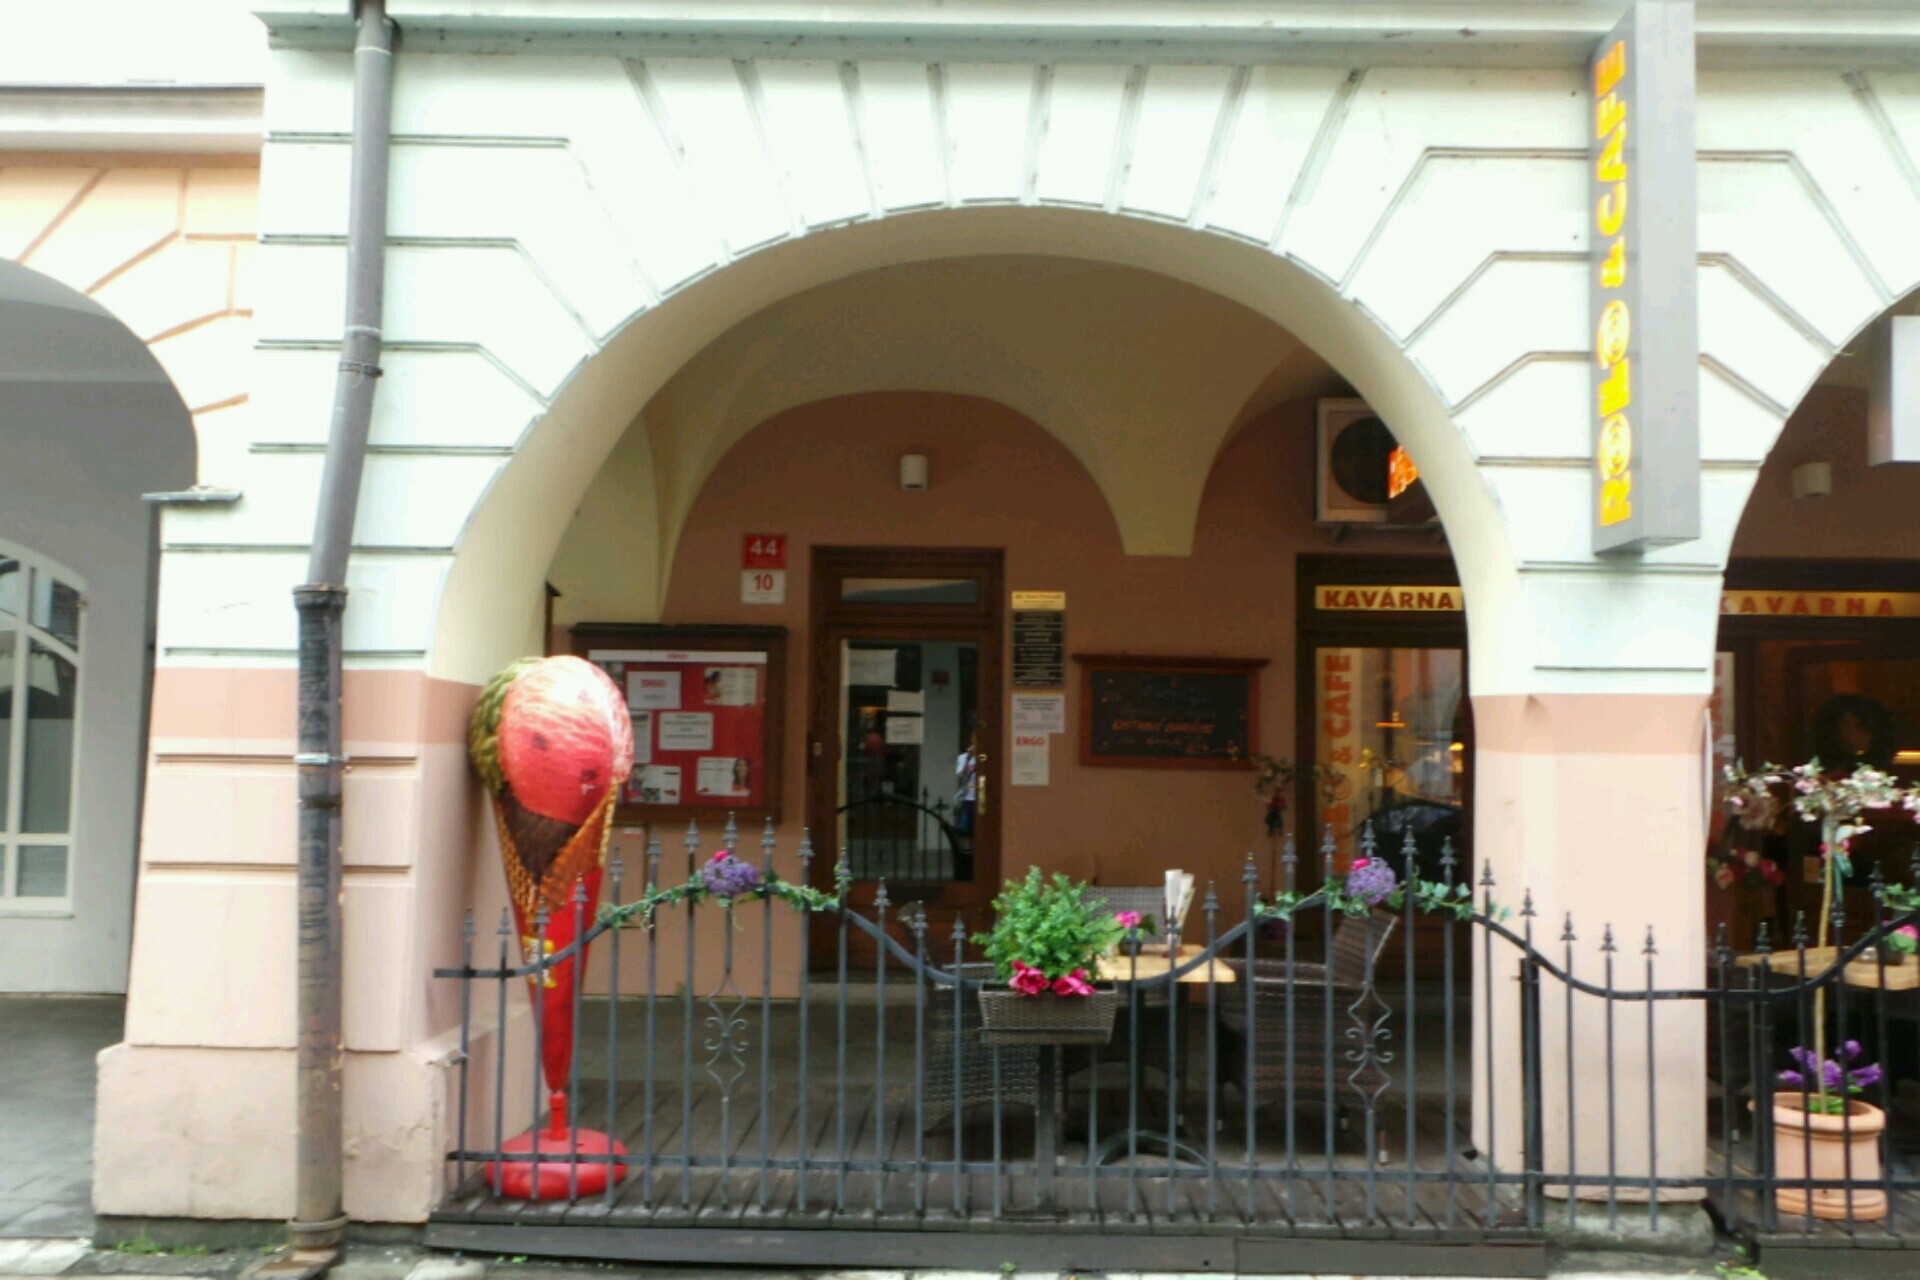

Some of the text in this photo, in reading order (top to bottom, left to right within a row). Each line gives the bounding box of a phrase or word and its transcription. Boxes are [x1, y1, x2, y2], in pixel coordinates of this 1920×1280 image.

[750, 539, 778, 556] 44
[753, 574, 773, 591] 10
[1016, 736, 1045, 746] ERGO
